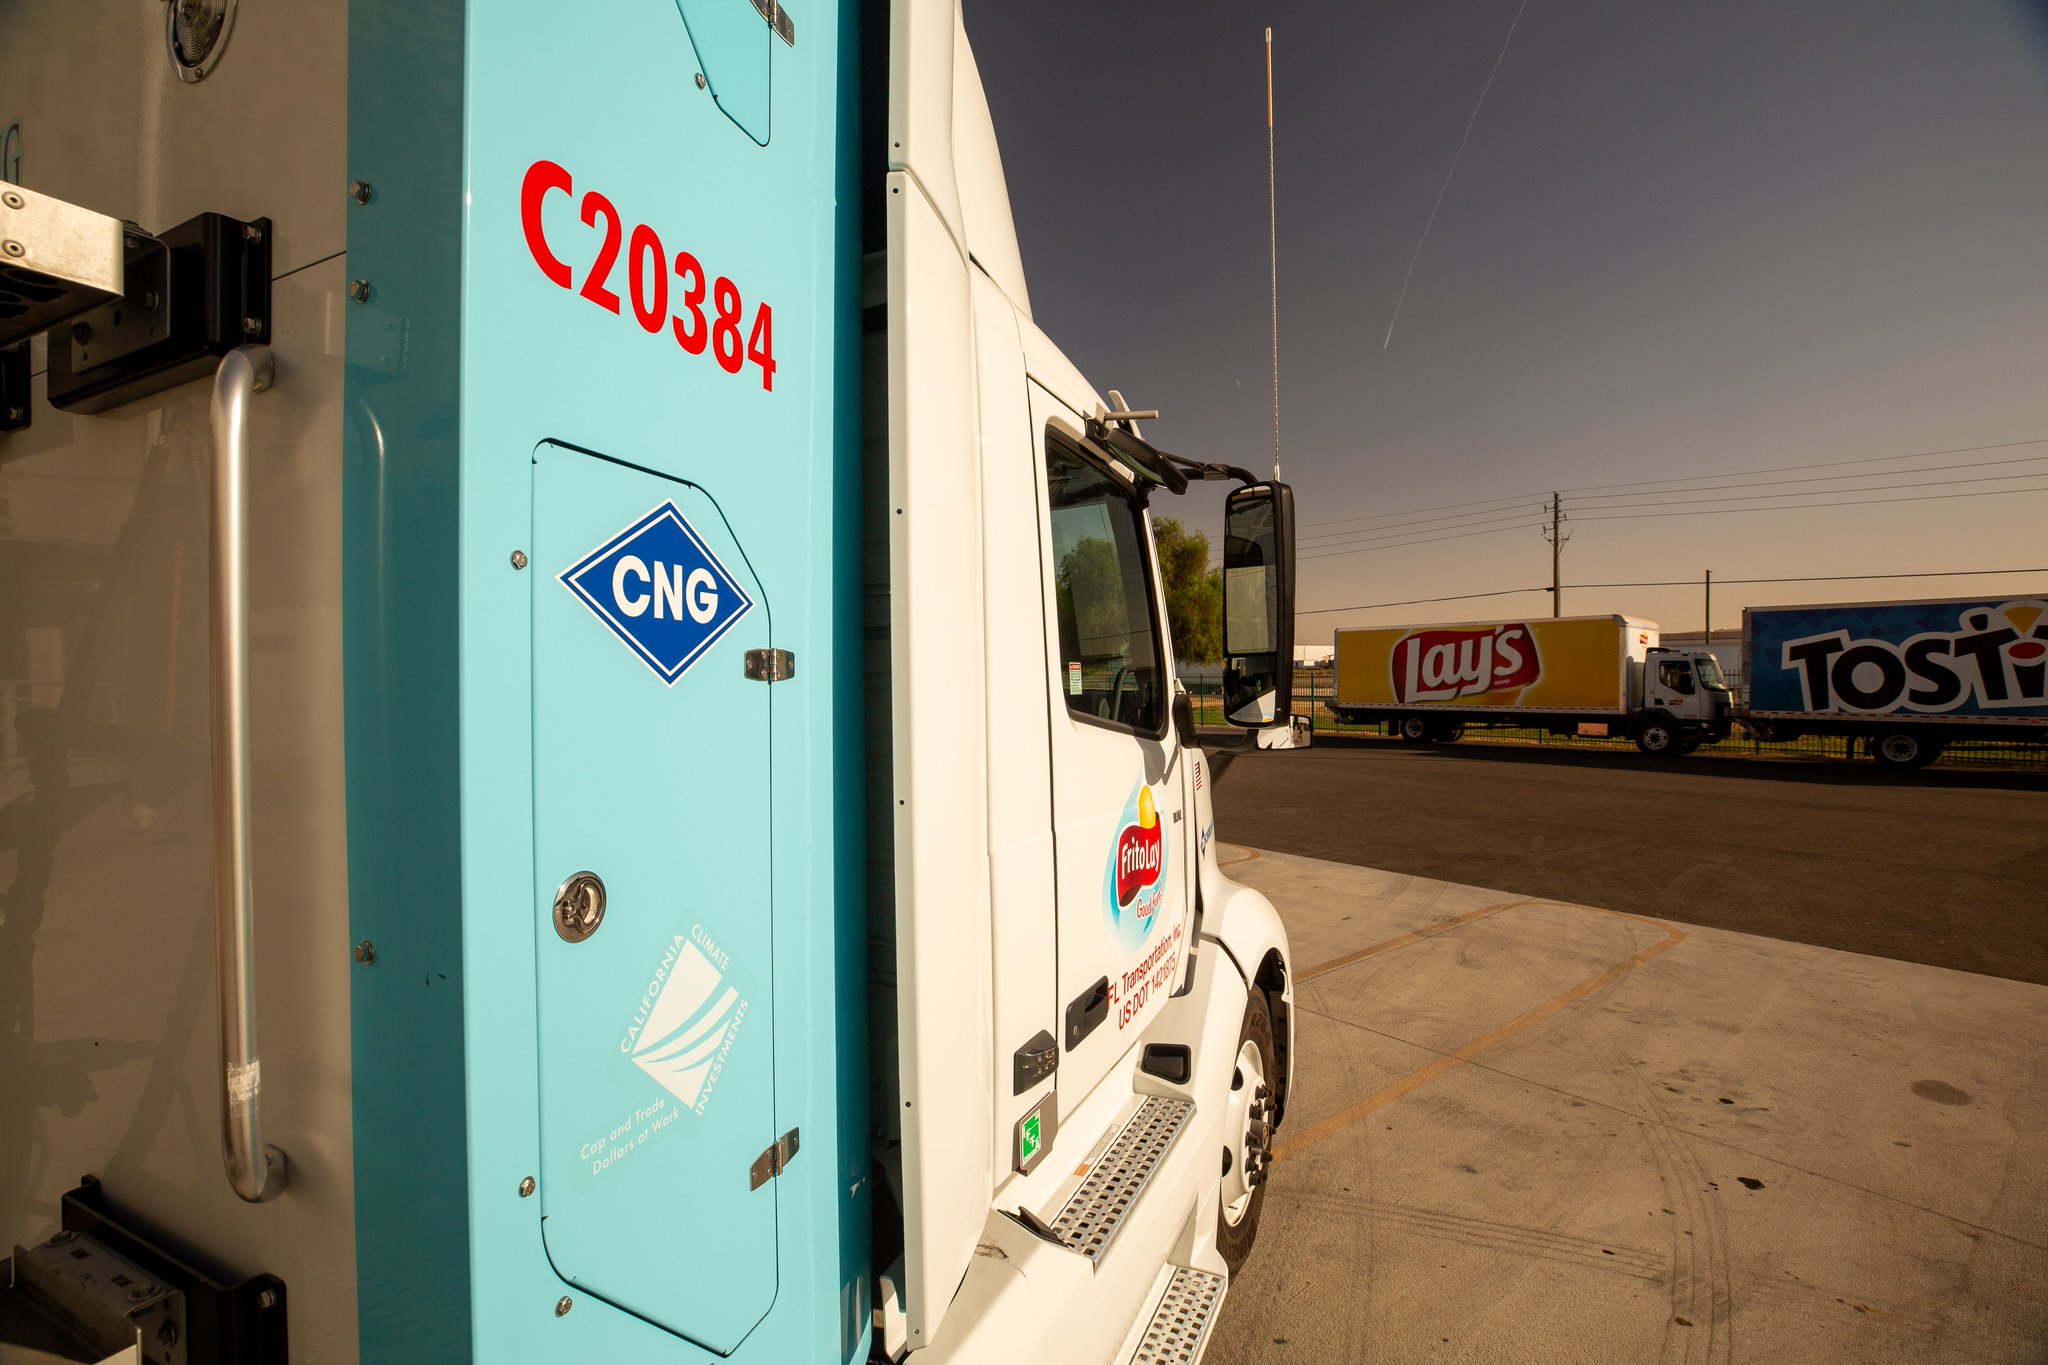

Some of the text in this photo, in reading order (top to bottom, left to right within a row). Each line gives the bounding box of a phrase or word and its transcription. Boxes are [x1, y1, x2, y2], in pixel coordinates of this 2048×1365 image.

[521, 159, 777, 393] C20384
[612, 554, 719, 625] CNG
[1404, 624, 1524, 704] Lay's
[691, 923, 731, 971] CLIMATE
[620, 934, 684, 1053] CALIFORNIA
[1107, 982, 1119, 1008] FL
[1118, 999, 1131, 1030] US
[1132, 979, 1149, 1015] DOT
[695, 999, 749, 1116] INVESTMENTS
[581, 1097, 664, 1160] Cap and Trade
[593, 1105, 679, 1175] Dollars at Work
